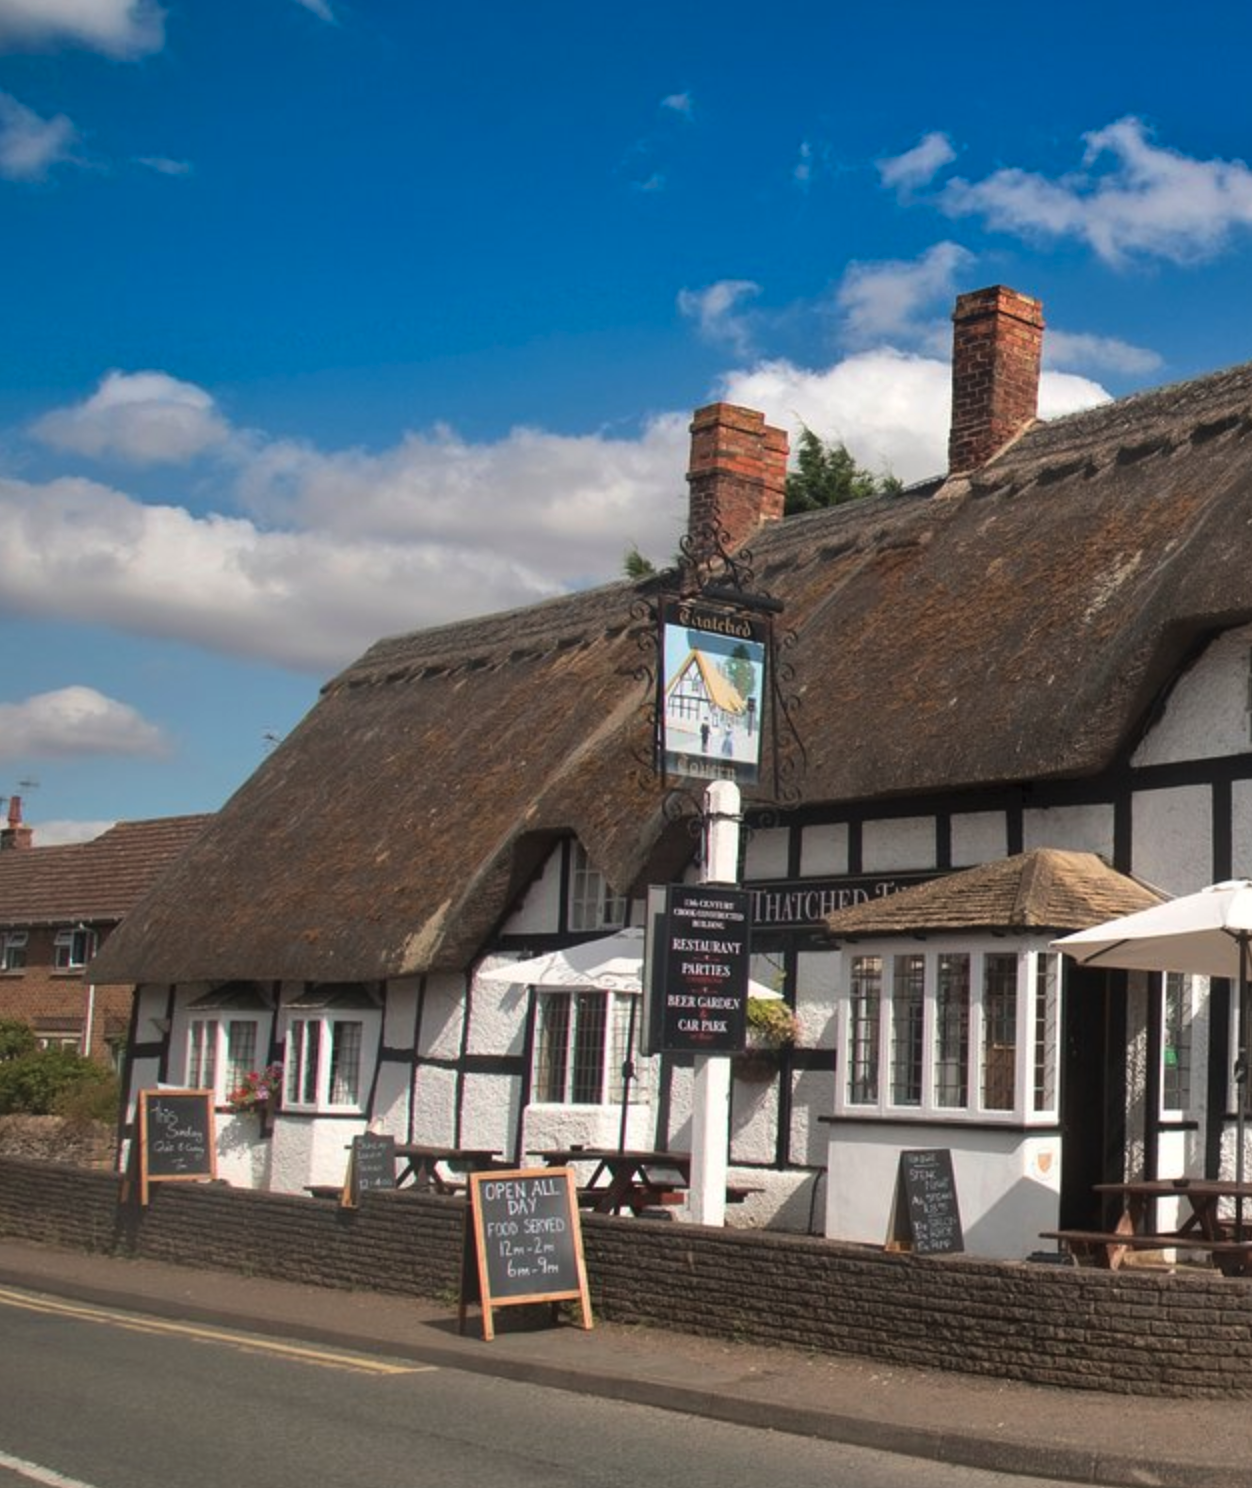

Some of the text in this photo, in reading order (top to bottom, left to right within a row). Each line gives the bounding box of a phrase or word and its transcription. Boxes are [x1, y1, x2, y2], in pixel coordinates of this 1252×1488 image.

[672, 938, 743, 955] RESTAURANT
[681, 962, 731, 977] PARTIES
[667, 994, 741, 1010] BEER GARDEN
[677, 1018, 728, 1033] CAR PARK
[485, 1179, 561, 1200] OPEN ALL
[508, 1197, 537, 1216] DAY
[487, 1216, 565, 1237] FOOD SERVED
